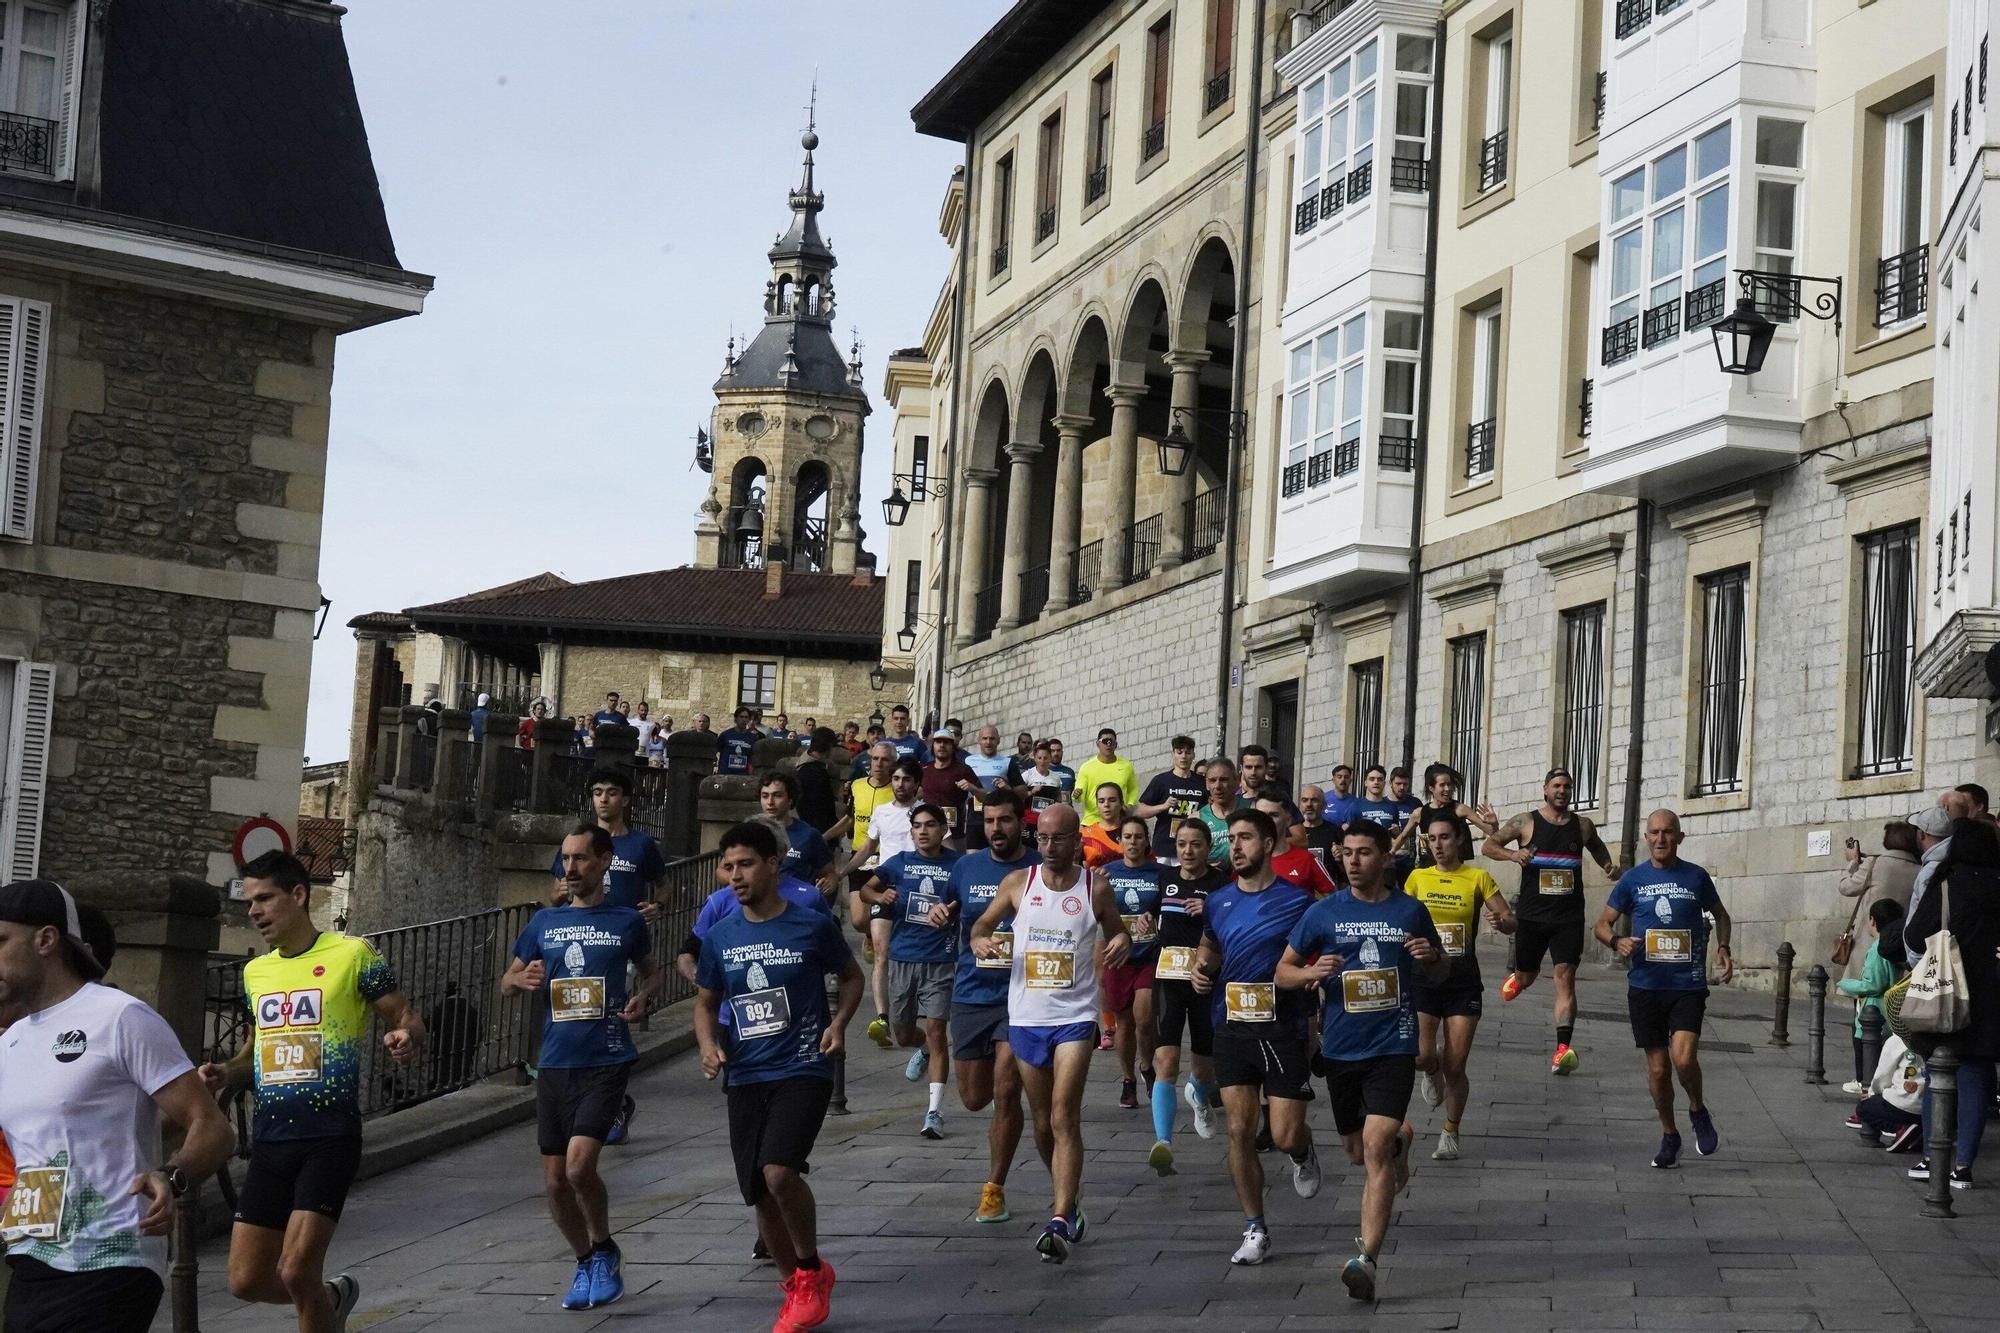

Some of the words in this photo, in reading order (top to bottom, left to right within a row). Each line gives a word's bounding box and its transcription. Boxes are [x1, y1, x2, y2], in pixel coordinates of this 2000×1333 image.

[1169, 788, 1202, 796] HEAD
[1552, 876, 1563, 886] 55
[1644, 882, 1678, 890] CONQUISTA
[1426, 892, 1462, 901] GAIKAR
[1646, 888, 1688, 896] ALMENDRA
[554, 926, 595, 934] CONQUISTA
[1029, 927, 1063, 936] Farmacia
[1347, 928, 1403, 936] ALMENDRA
[554, 931, 610, 941] ALMENDRA
[731, 943, 774, 954] CONQUISTA
[1657, 938, 1680, 950] 689
[733, 948, 791, 963] ALMENDRA
[1172, 954, 1190, 967] 197
[764, 957, 803, 966] KONKISTA
[1036, 960, 1060, 975] 527
[1358, 980, 1386, 996] 358
[562, 988, 590, 1004] 356
[1240, 993, 1257, 1007] 86
[746, 1001, 774, 1021] 892
[275, 1045, 304, 1066] 679
[12, 1186, 41, 1217] 331
